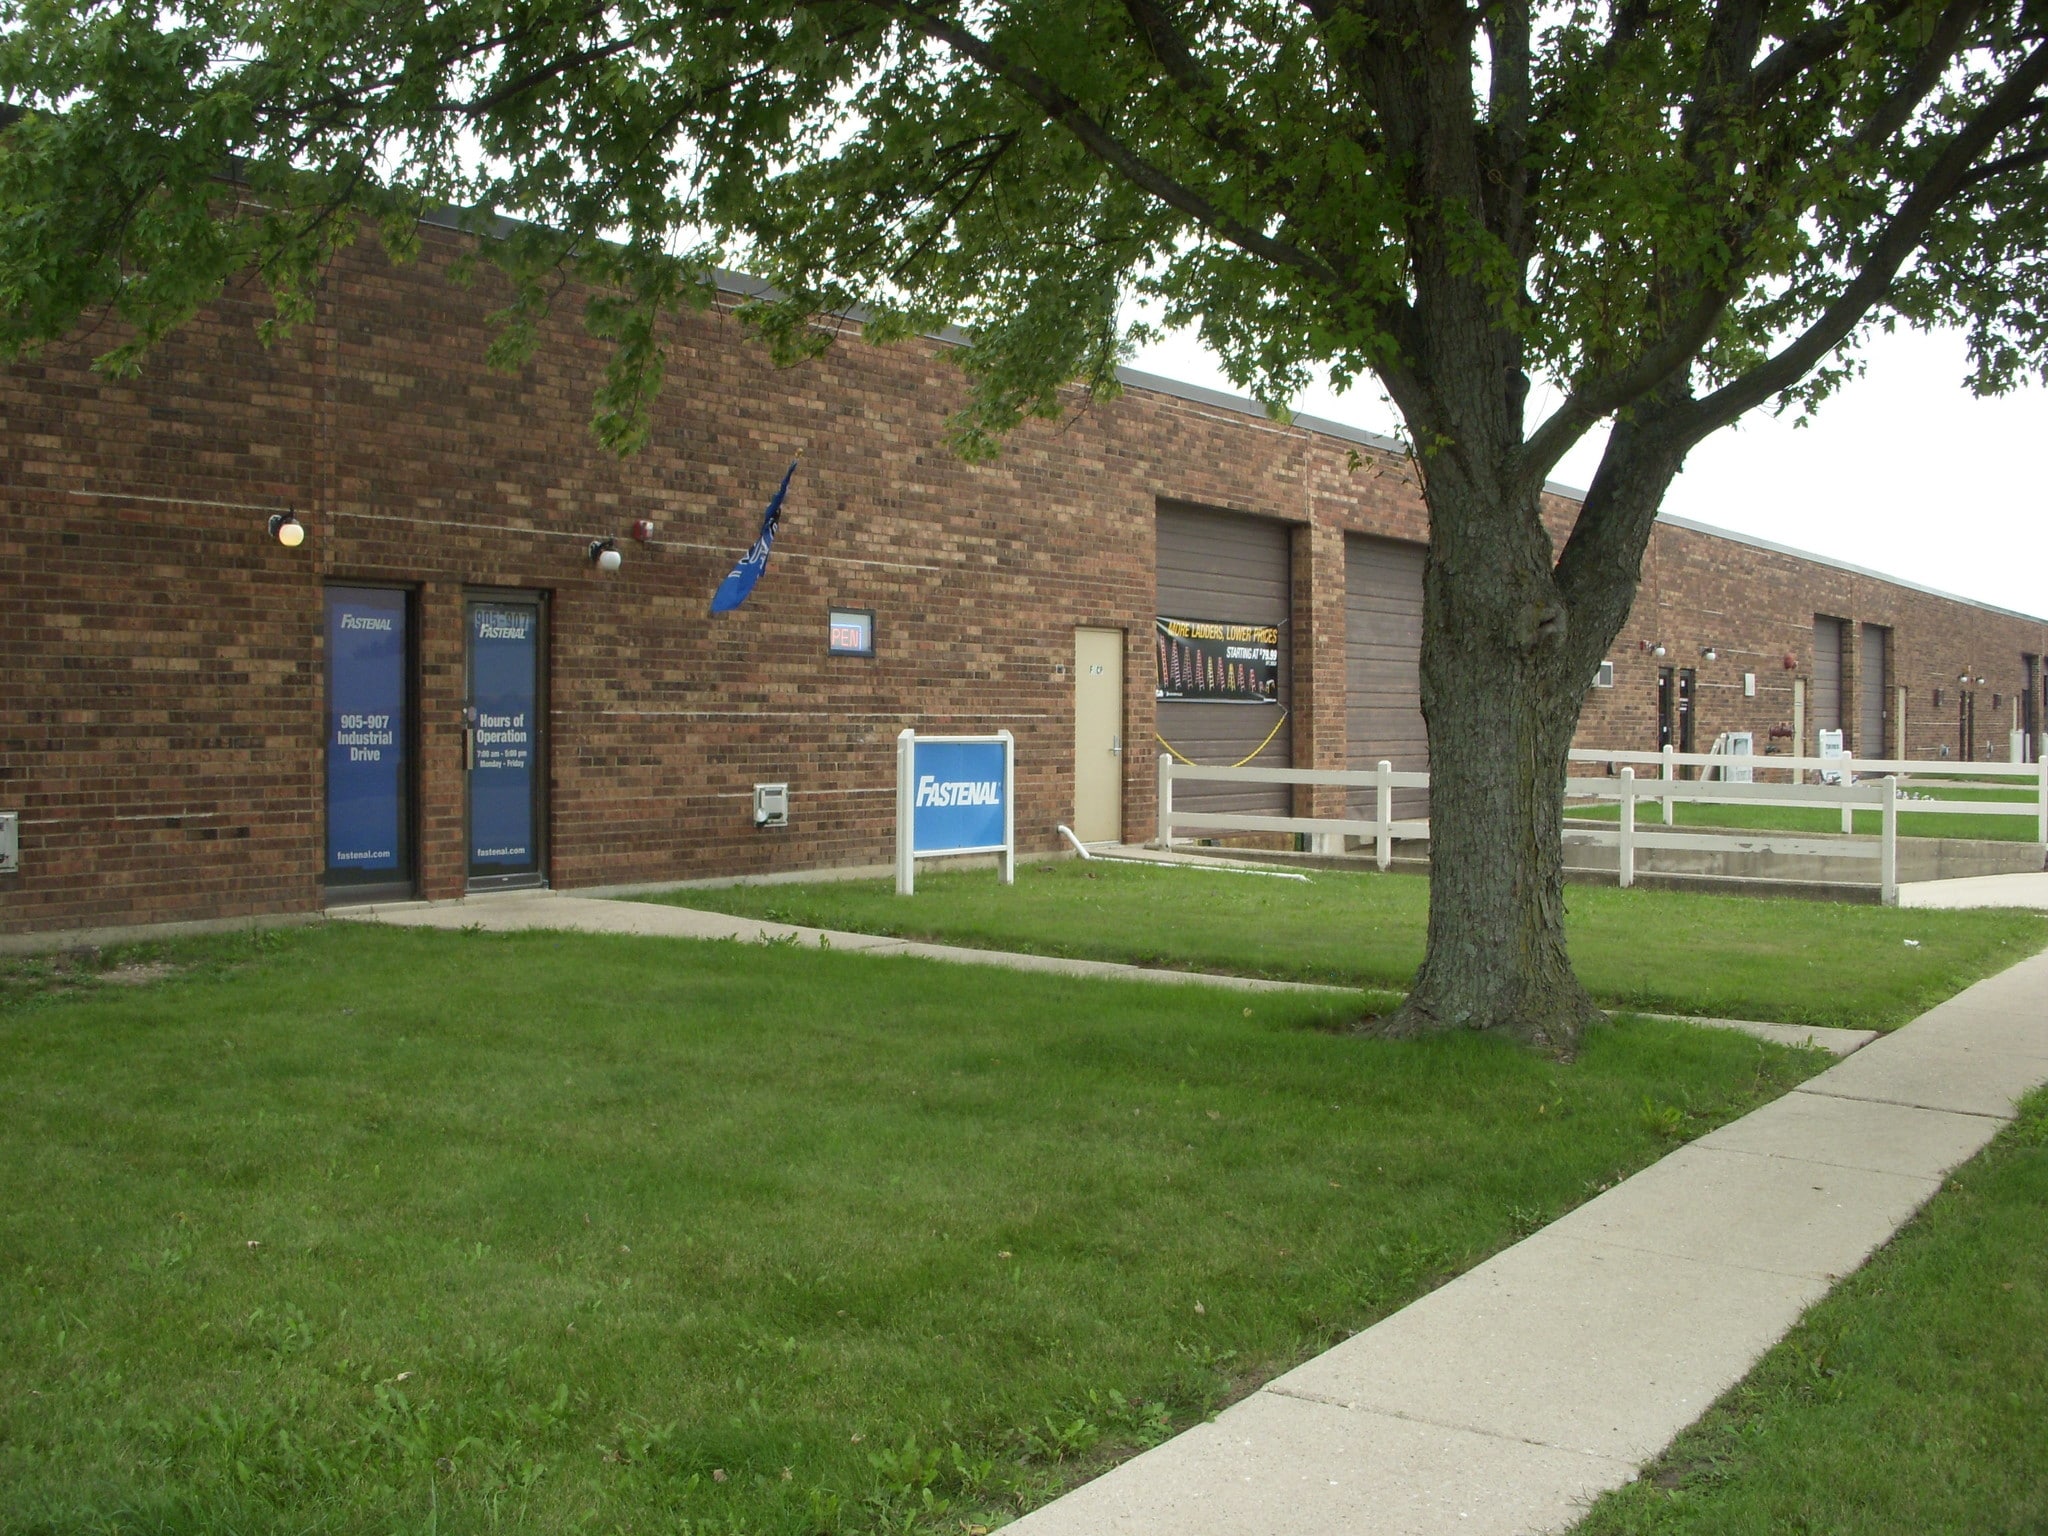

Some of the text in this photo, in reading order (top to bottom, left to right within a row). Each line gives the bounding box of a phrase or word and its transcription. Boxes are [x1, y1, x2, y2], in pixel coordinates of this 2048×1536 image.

[341, 613, 392, 631] FASTENAL
[479, 622, 526, 639] FASTENAL
[830, 627, 860, 648] PEN
[1167, 621, 1278, 644] MORE LADDERS, LOWER PRICES
[1226, 646, 1253, 660] STARTING
[1252, 648, 1260, 660] AT
[340, 714, 390, 729] 905-907
[480, 713, 525, 728] Hours of
[337, 730, 393, 745] Industrial
[476, 729, 527, 746] Operation
[350, 747, 381, 761] Drive
[480, 759, 502, 769] Monday
[506, 759, 525, 768] Friday
[916, 775, 1000, 807] FASTENAL
[337, 850, 391, 860] fastenal.com
[477, 846, 526, 857] fastenal.com
